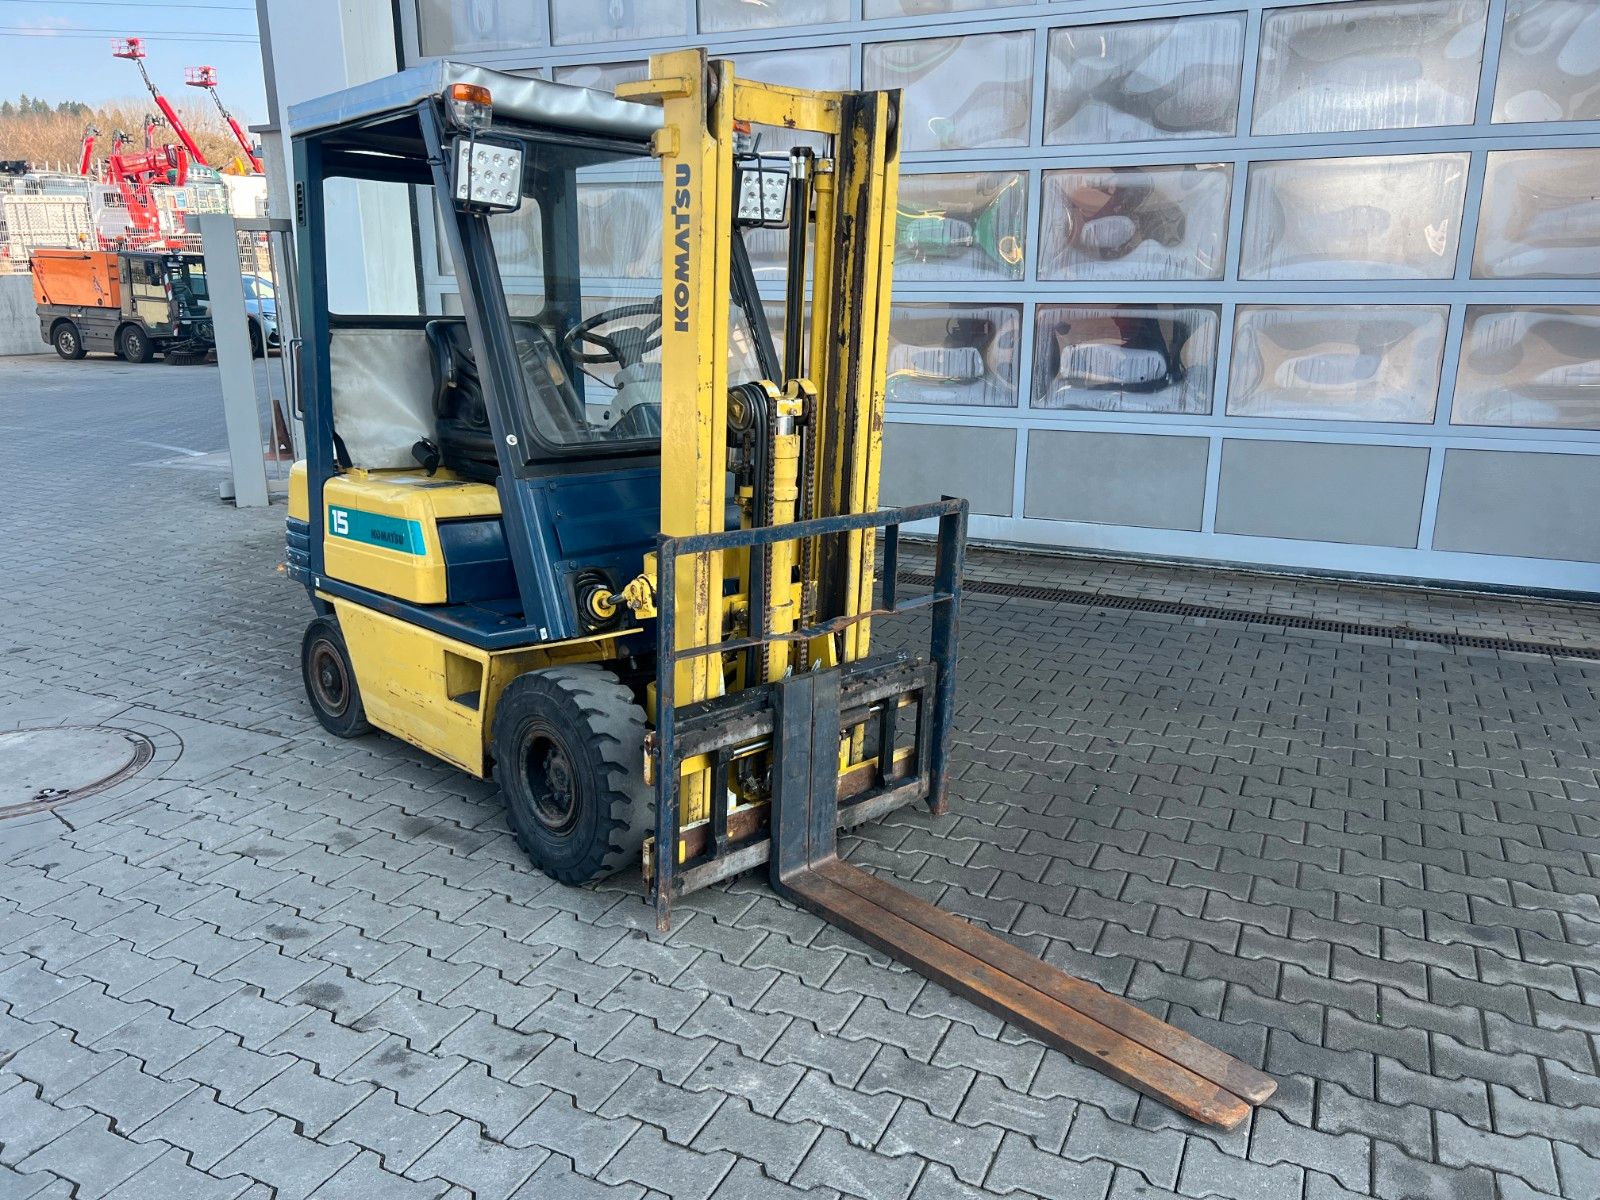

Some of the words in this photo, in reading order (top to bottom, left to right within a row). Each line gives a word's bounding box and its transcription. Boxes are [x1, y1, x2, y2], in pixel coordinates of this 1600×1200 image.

[671, 163, 691, 332] KOMATSU
[332, 509, 349, 535] 15
[371, 529, 404, 545] KOMATSU
